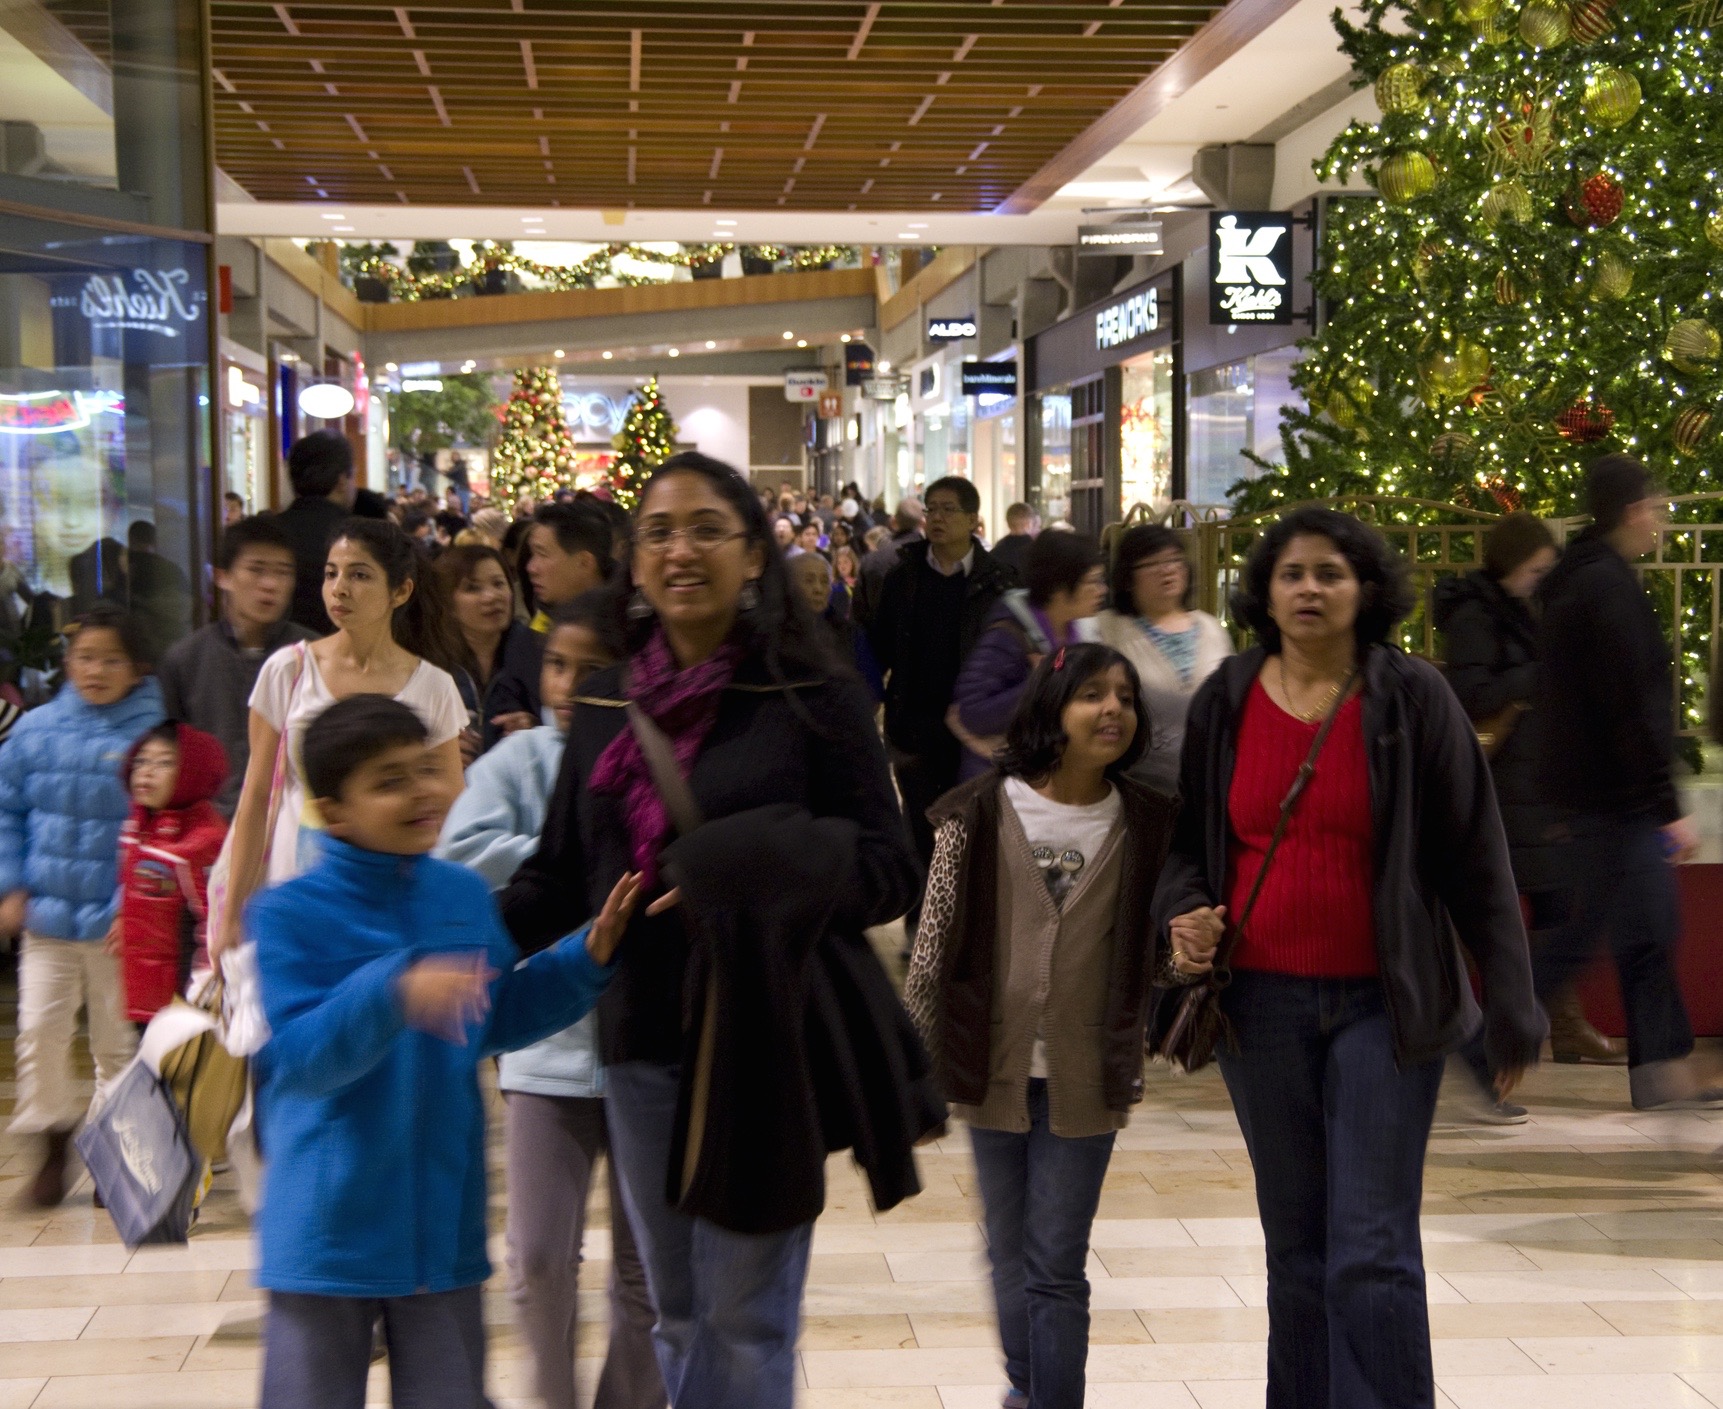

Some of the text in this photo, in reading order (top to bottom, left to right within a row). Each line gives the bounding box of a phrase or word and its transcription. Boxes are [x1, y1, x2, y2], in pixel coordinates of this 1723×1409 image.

[1081, 232, 1159, 245] FIREWORKS
[1220, 285, 1282, 313] Kiehl's
[928, 322, 977, 337] ALDO
[1097, 287, 1158, 351] FIREWORKS
